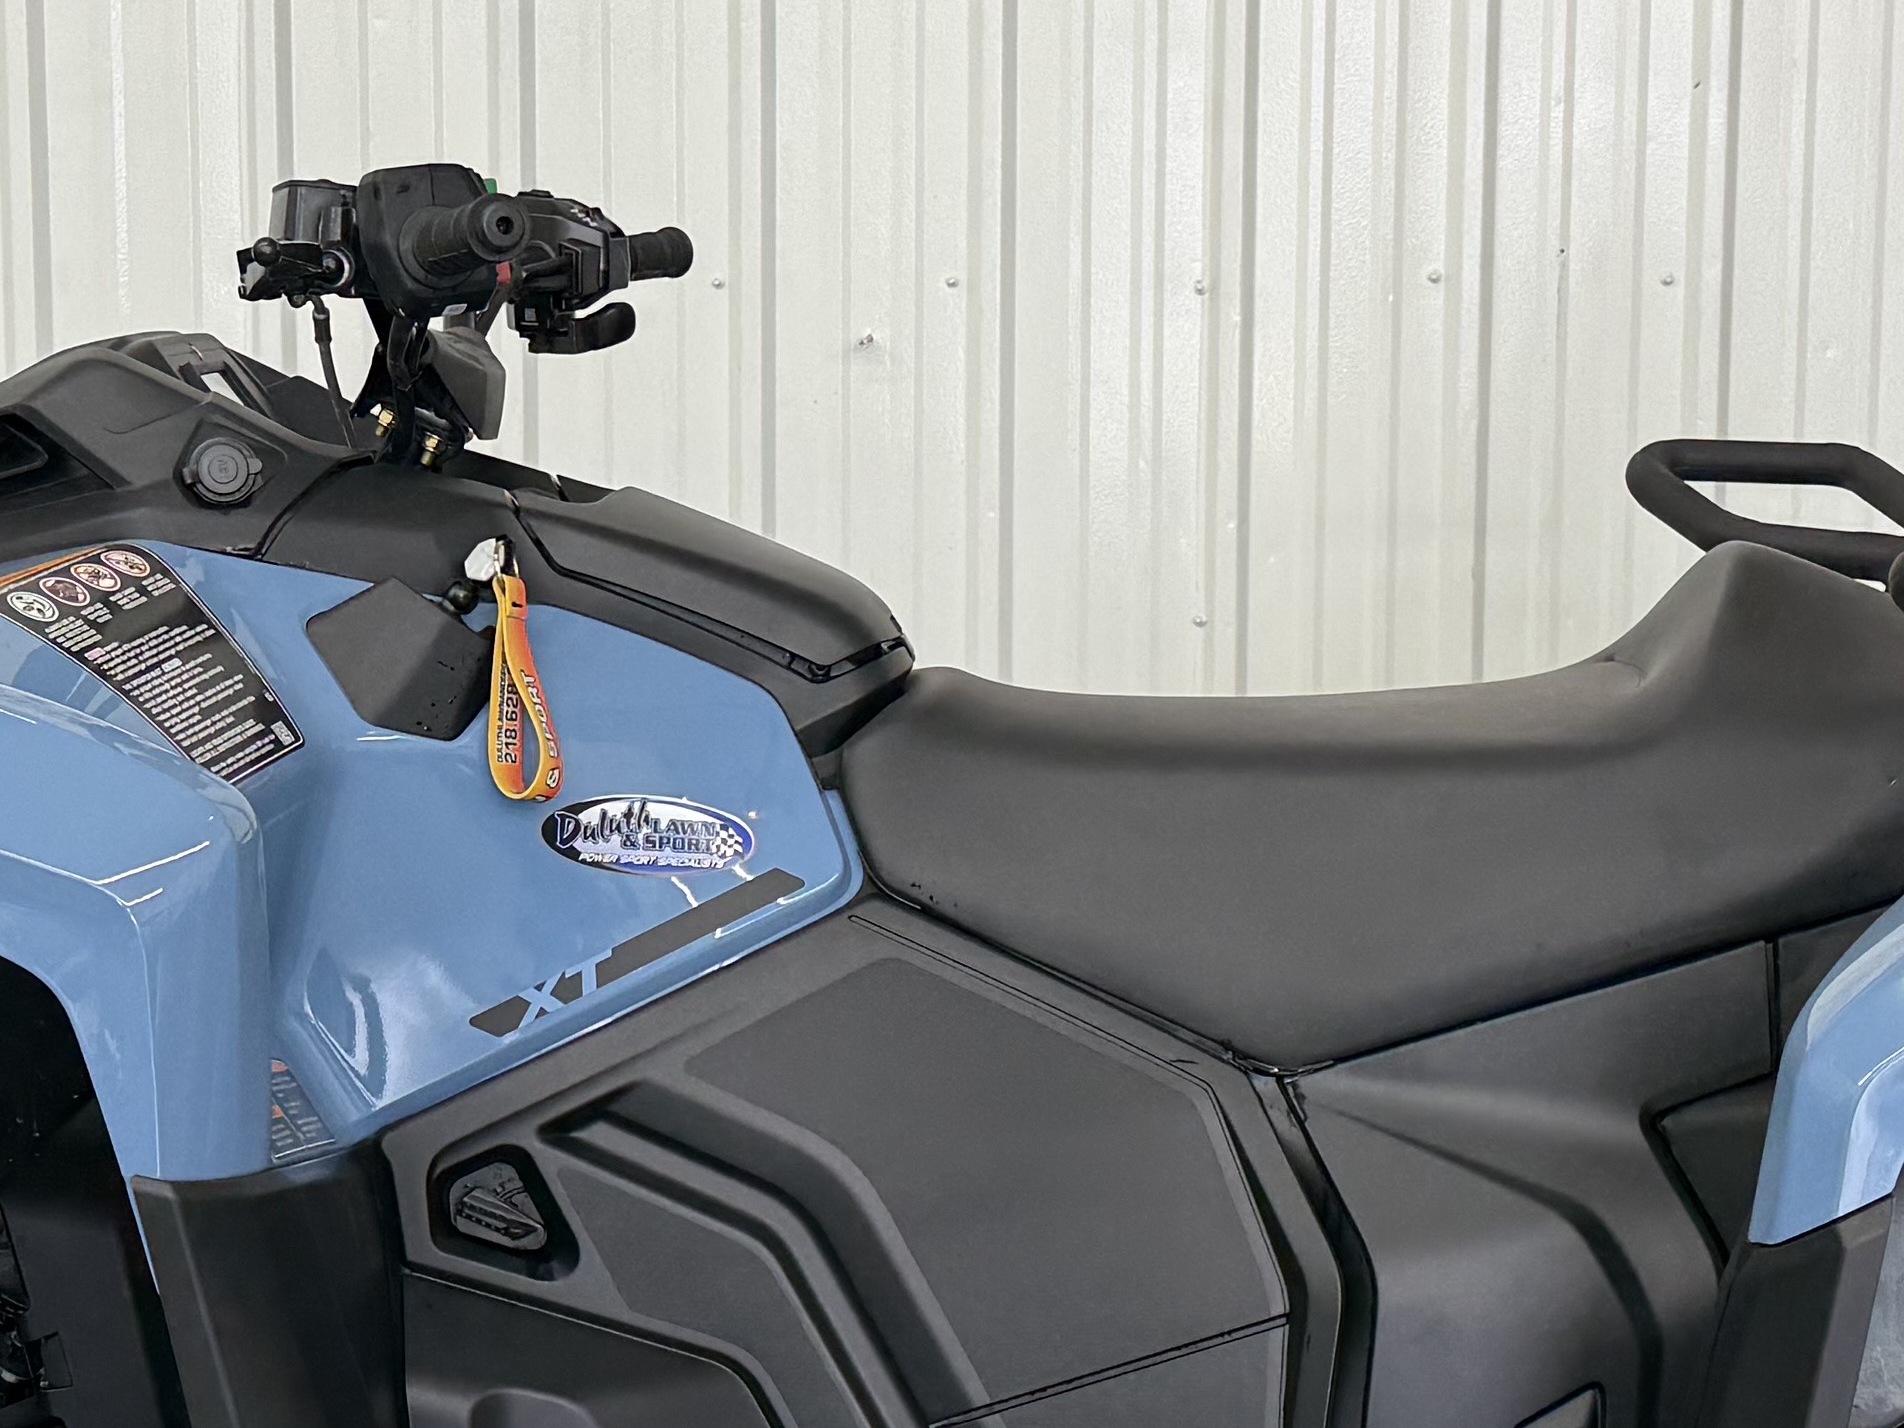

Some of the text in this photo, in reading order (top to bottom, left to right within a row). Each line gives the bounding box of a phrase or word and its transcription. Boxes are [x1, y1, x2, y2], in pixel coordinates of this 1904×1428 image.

[520, 668, 558, 758] SPORT
[555, 798, 718, 848] Duluth LAWN
[621, 833, 716, 854] & SPORT
[579, 851, 725, 869] POWER SPORT SPECIALISTS
[517, 949, 613, 1028] XT
